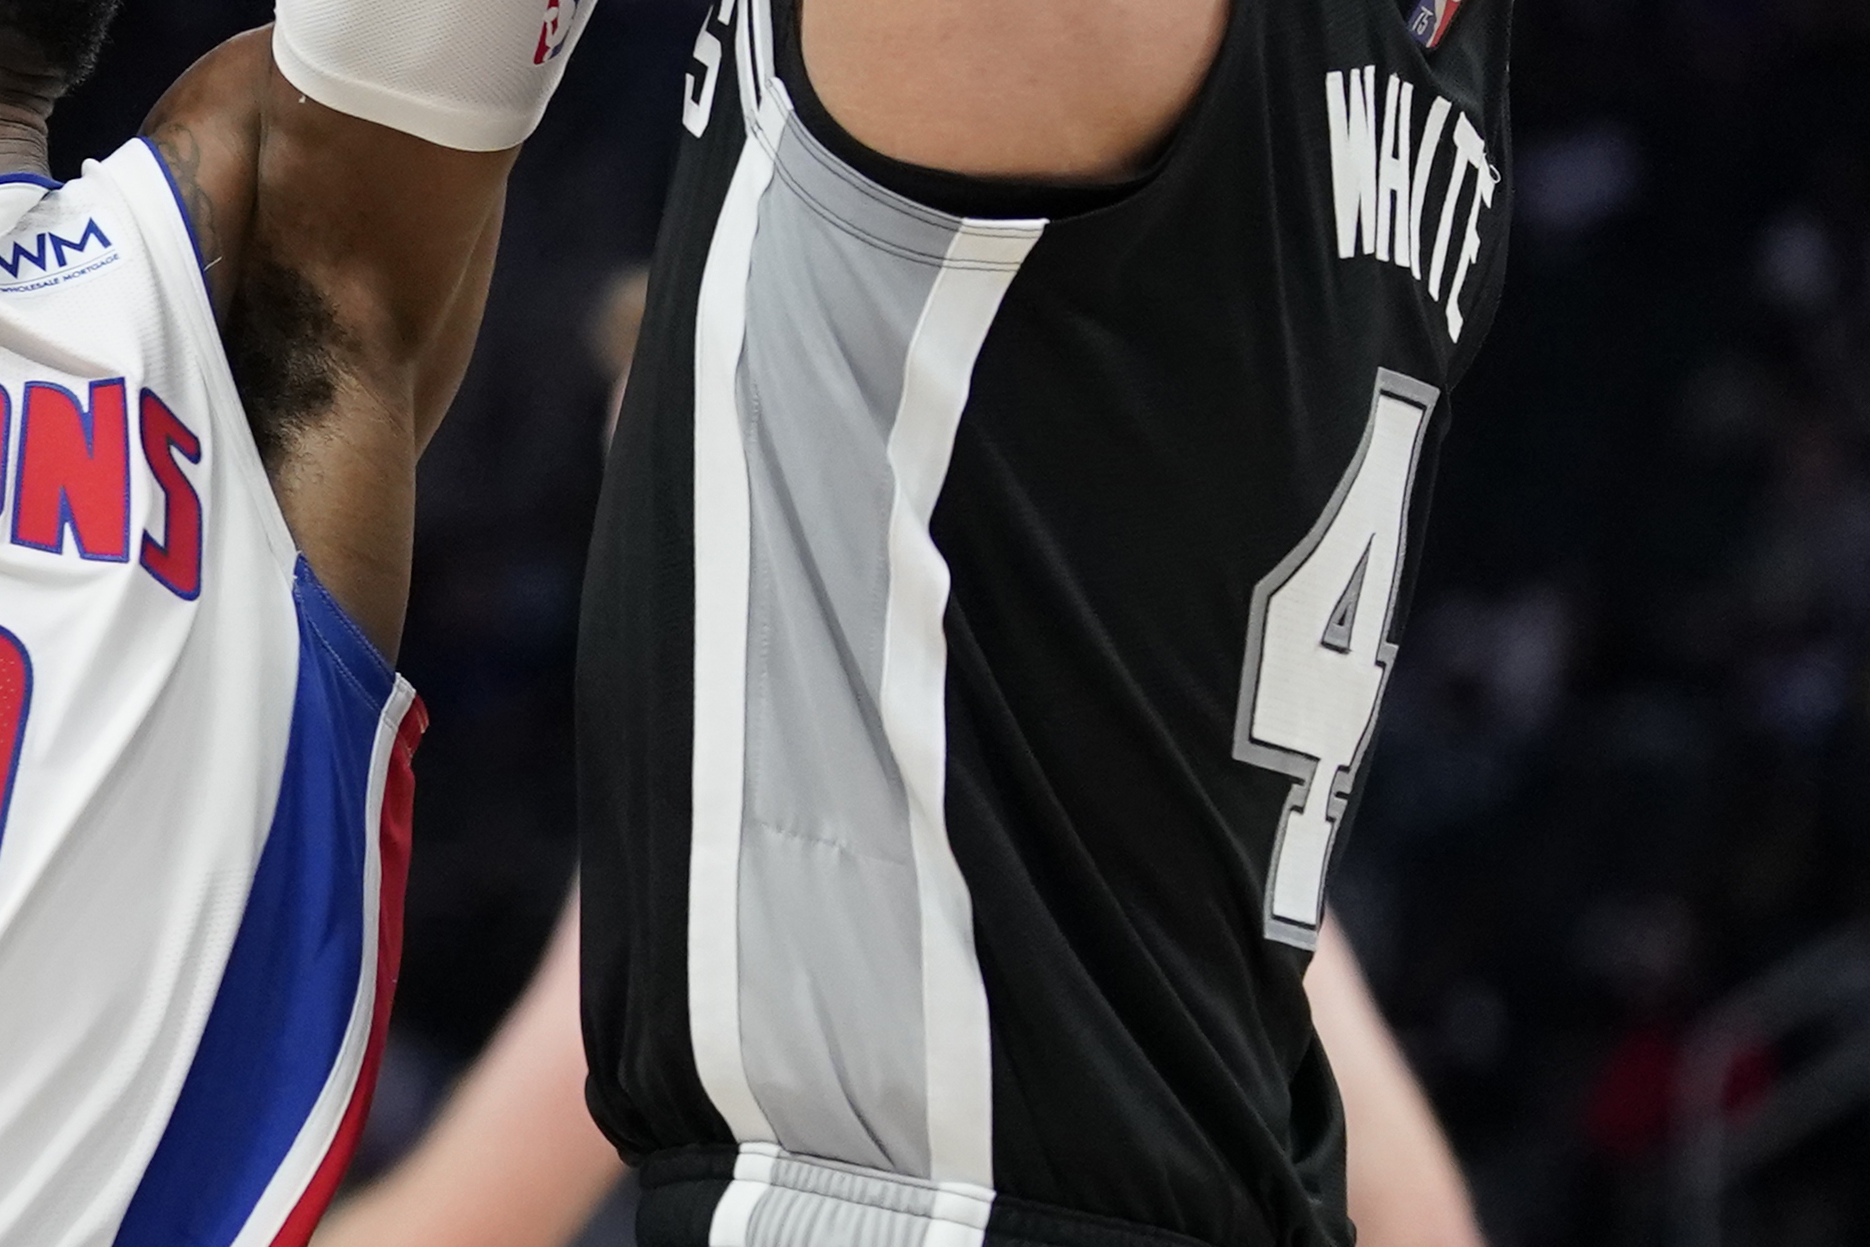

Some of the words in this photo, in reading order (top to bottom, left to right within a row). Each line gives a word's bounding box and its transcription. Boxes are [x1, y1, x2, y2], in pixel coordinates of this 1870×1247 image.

[1412, 5, 1434, 35] 75
[0, 277, 60, 293] WHOLESALE
[62, 253, 120, 283] MORTGAGE
[1325, 64, 1496, 344] WHITE
[1231, 365, 1439, 951] 4
